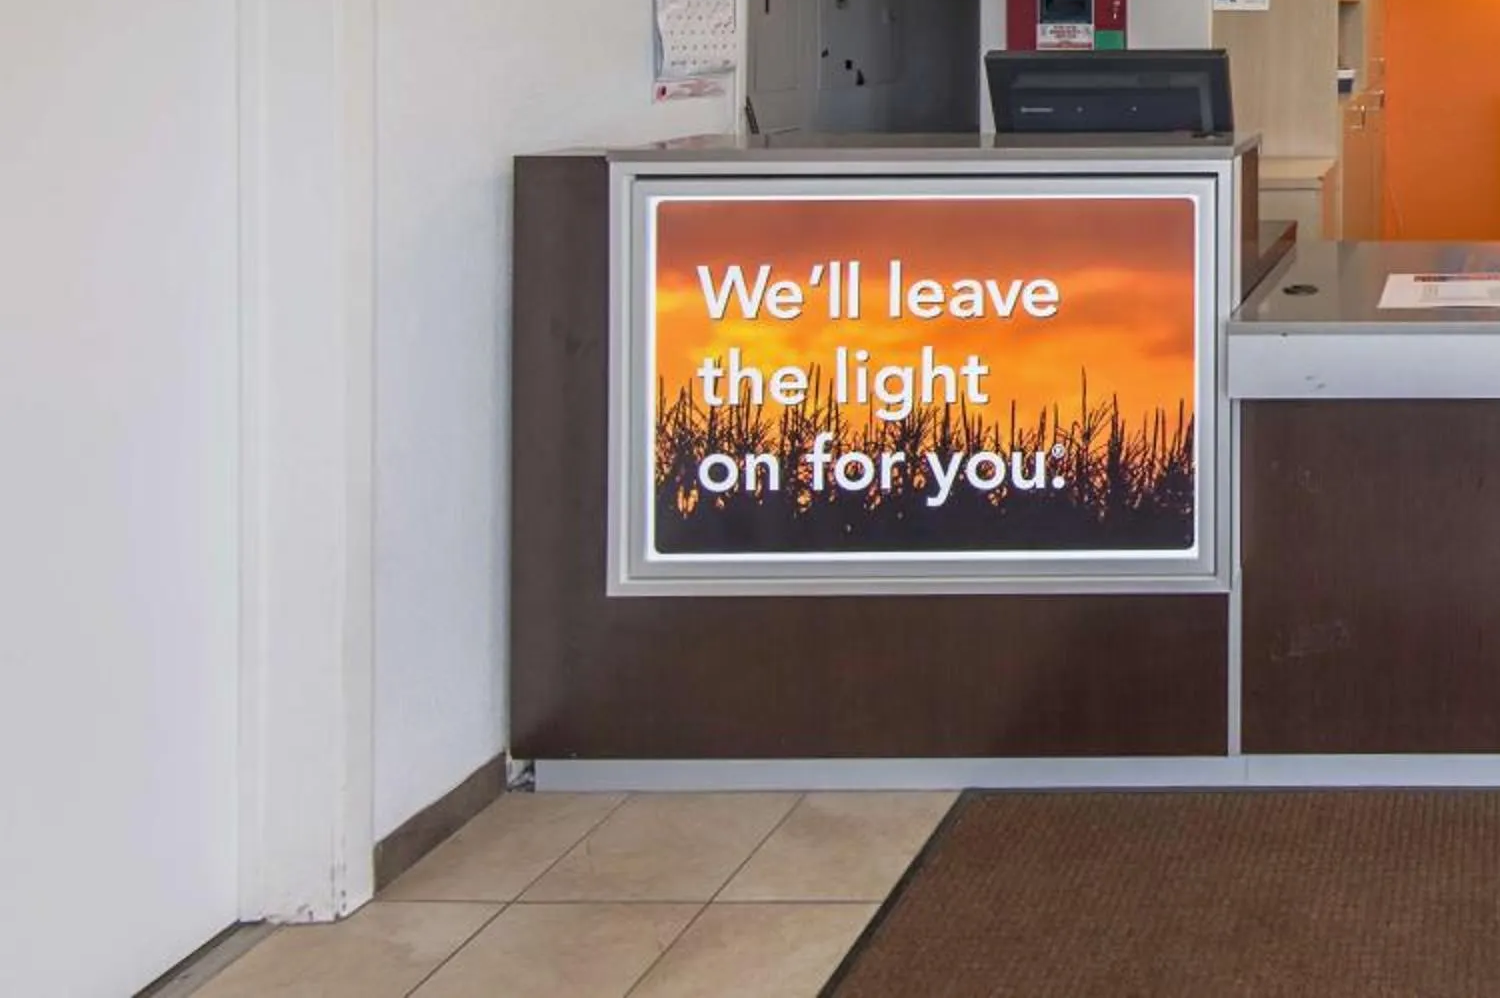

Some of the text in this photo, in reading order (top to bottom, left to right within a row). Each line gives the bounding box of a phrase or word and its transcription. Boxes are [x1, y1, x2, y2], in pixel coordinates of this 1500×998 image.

[889, 259, 1060, 319] leave
[697, 345, 990, 421] the light
[698, 451, 780, 494] on
[808, 431, 905, 492] for
